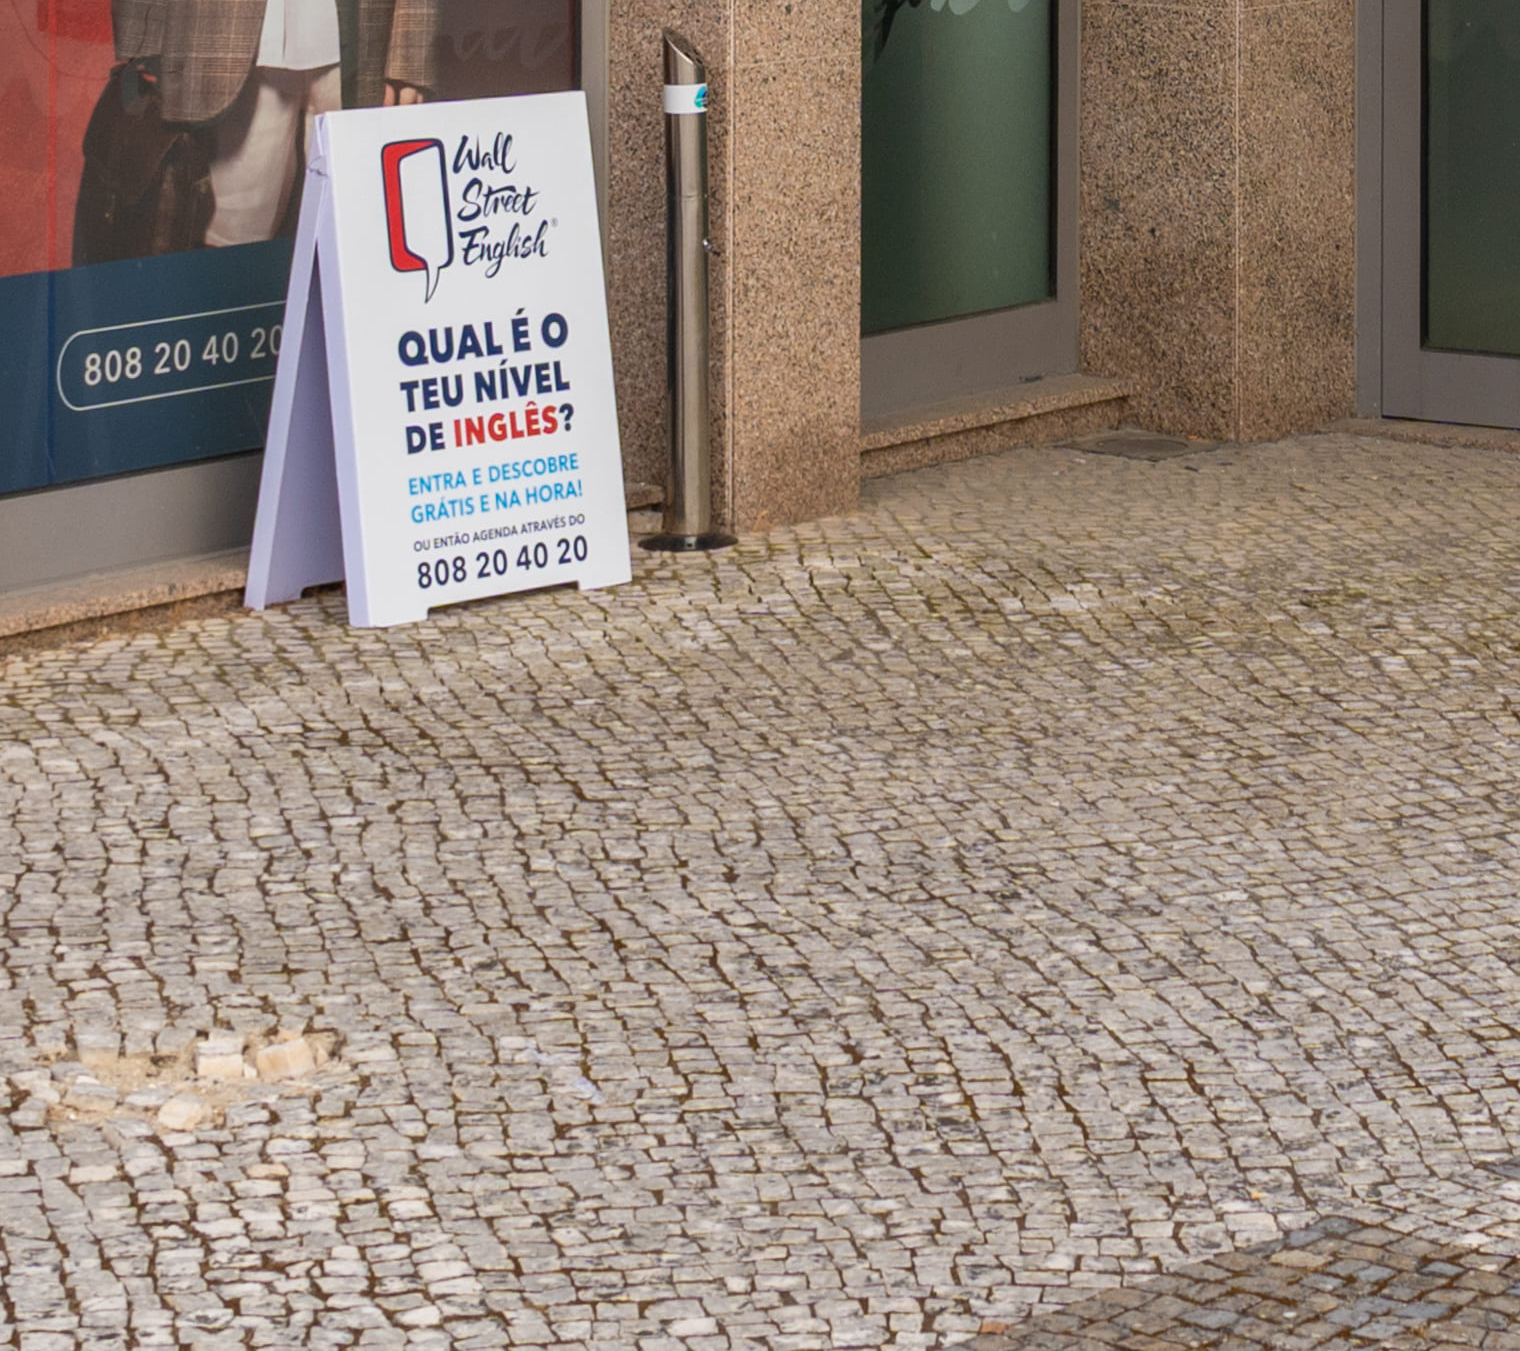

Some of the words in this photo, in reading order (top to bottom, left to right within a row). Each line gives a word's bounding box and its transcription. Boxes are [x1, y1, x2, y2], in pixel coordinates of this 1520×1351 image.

[452, 131, 517, 174] Wall
[457, 177, 541, 222] Street
[458, 219, 550, 279] English
[83, 346, 144, 387] 808
[153, 339, 192, 375] 20
[201, 332, 240, 366] 40
[250, 325, 283, 359] 20
[397, 321, 504, 367] QUAL
[511, 307, 532, 352] É
[541, 312, 569, 348] O
[399, 374, 465, 413] TEU
[474, 358, 571, 404] NÍVEL
[405, 421, 446, 455] DE
[453, 401, 575, 448] INGLÊS?
[408, 470, 467, 496] ENTRA
[472, 467, 482, 486] E
[488, 452, 580, 484] DESCOBRE
[411, 495, 475, 525] GRÁTIS
[480, 494, 489, 513] E
[495, 489, 522, 510] NA
[526, 479, 583, 507] HORA!
[413, 539, 431, 552] OU
[433, 530, 470, 550] ENTÃO
[472, 524, 519, 544] AGENDA
[520, 514, 567, 535] ATRAVÉS
[568, 513, 586, 527] DO
[417, 555, 467, 590] 808
[476, 548, 508, 579] 20
[516, 541, 549, 571] 40
[556, 535, 589, 565] 20
